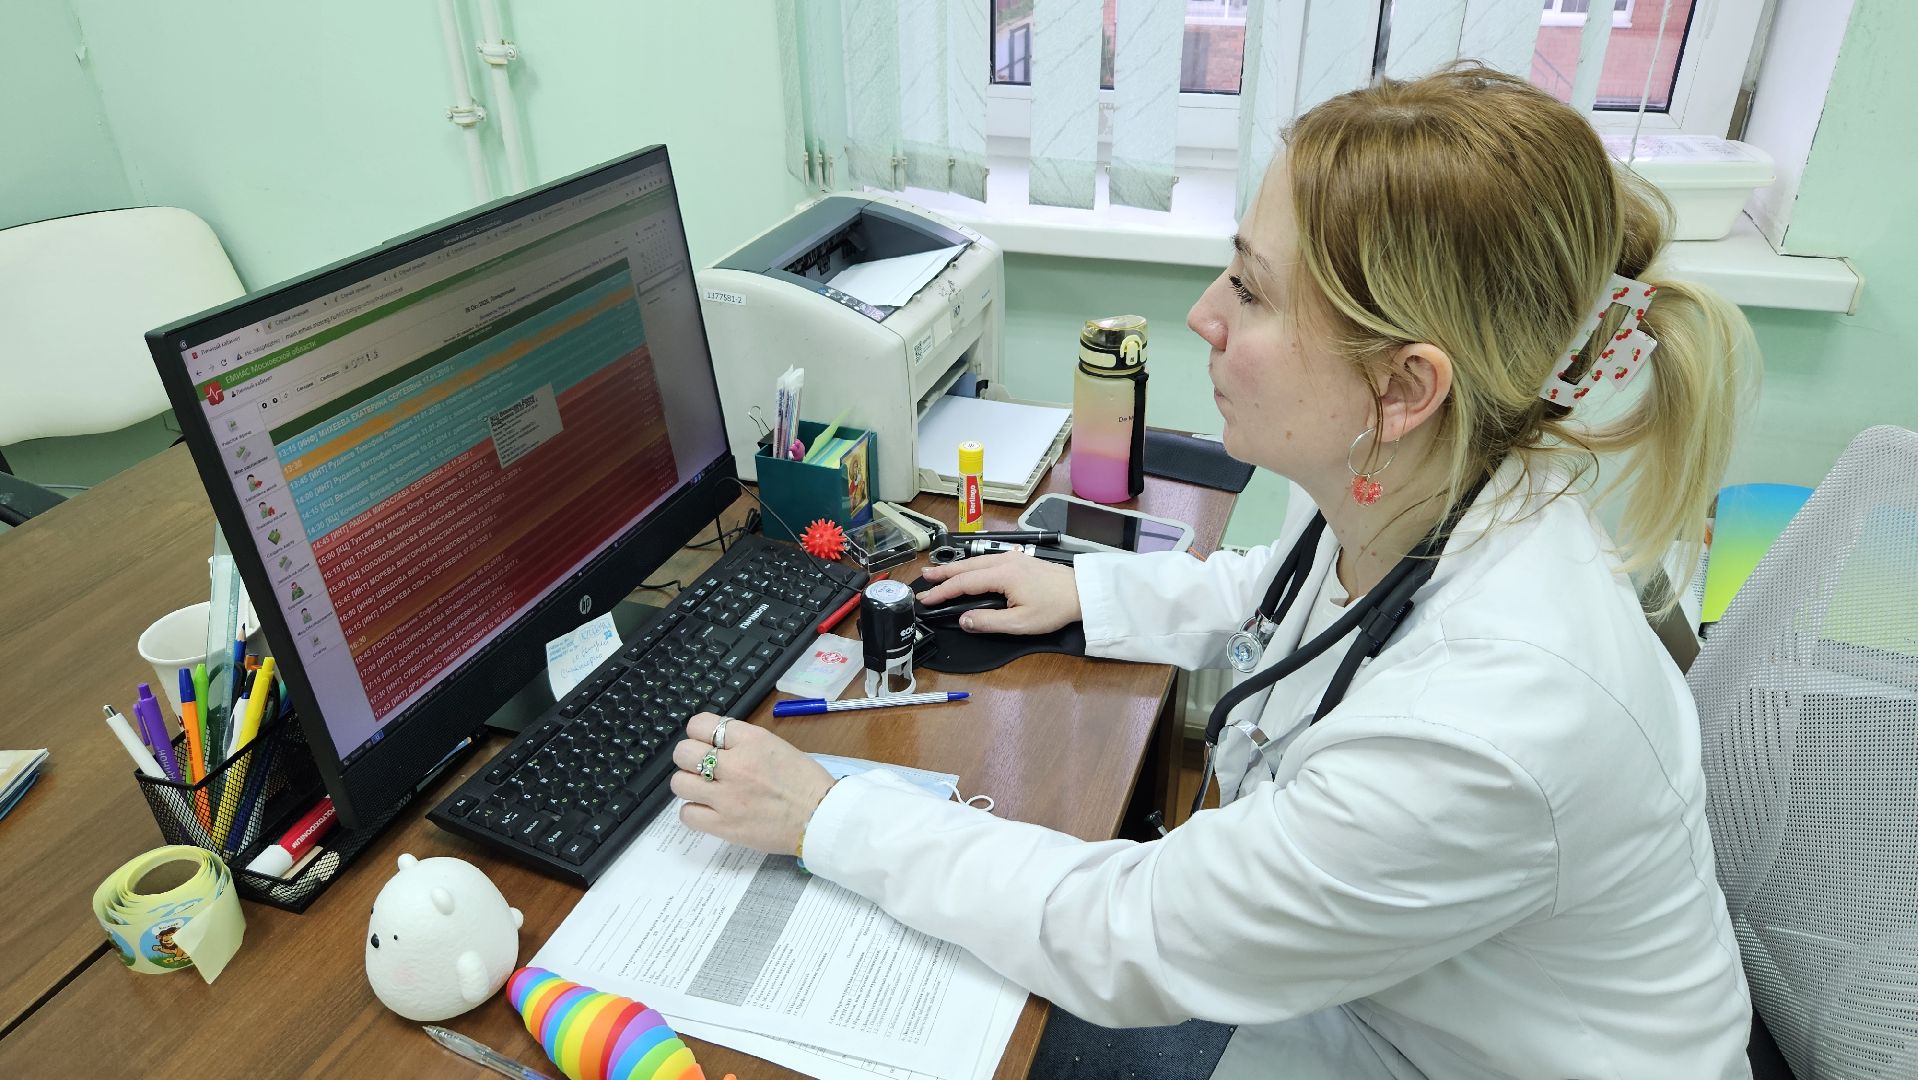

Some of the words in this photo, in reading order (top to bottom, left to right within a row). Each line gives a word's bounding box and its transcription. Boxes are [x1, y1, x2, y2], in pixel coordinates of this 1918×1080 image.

[224, 367, 250, 385] ЕМИАС
[250, 349, 291, 374] Московской
[290, 338, 317, 357] области
[277, 442, 297, 458] 13:15
[317, 415, 350, 438] МИХЕЕВА
[350, 397, 387, 421] ЕКАТЕРИНА
[289, 474, 309, 490] 13:45
[295, 489, 314, 505] 14:00
[969, 484, 978, 515] Berlingo
[301, 504, 320, 521] 14:15
[306, 519, 325, 536] 14:30
[312, 534, 330, 551] 14:45
[329, 523, 349, 541] [ИНТ]
[372, 486, 410, 515] МИРОСЛАВА
[409, 467, 443, 492] СЕРГЕЕВНА
[317, 549, 336, 565] 15:00
[334, 540, 350, 556] [КЦ]
[349, 524, 375, 546] Тухтаев
[374, 505, 407, 531] Мухаммад
[406, 495, 424, 511] Юсуф
[328, 577, 346, 594] 15:30
[345, 568, 360, 584] [КЦ]
[359, 531, 418, 574] КОЛОКОЛЬНИКОВА
[417, 507, 456, 537] ВЛАДИСЛАВА
[455, 482, 494, 512] АНАТОЛЬЕВНА
[333, 592, 351, 609] 15:45
[350, 580, 369, 598] [ИНТ]
[368, 562, 396, 586] МОРЕВА
[395, 542, 428, 568] ВИКТОРИЯ
[426, 509, 477, 547] КОНСТАНТИНОВНА
[322, 563, 341, 580] 15:15
[340, 554, 355, 570] [КЦ]
[338, 606, 356, 623] 16:00
[406, 551, 438, 577] ВИКТОРИЯ
[437, 531, 468, 556] ПАВЛОВНА
[344, 620, 361, 637] 16:15
[360, 608, 379, 626] [ИНТ]
[378, 586, 411, 613] ЛАЗАРЕВА
[411, 572, 431, 591] ОЛЬГА
[430, 550, 463, 577] СЕРГЕЕВНА
[392, 619, 433, 654] РОДЗИНСКАЯ
[432, 610, 445, 625] ЕВА
[444, 577, 491, 616] ВЛАДИСЛАВОВНА
[418, 600, 438, 619] София
[397, 640, 426, 667] ДОБРОТА
[445, 602, 478, 631] АНДРЕЕВНА
[433, 635, 455, 656] РОМАН
[454, 609, 489, 640] ВАСИЛЬЕВИЧ
[442, 646, 462, 666] ПАВЕЛ
